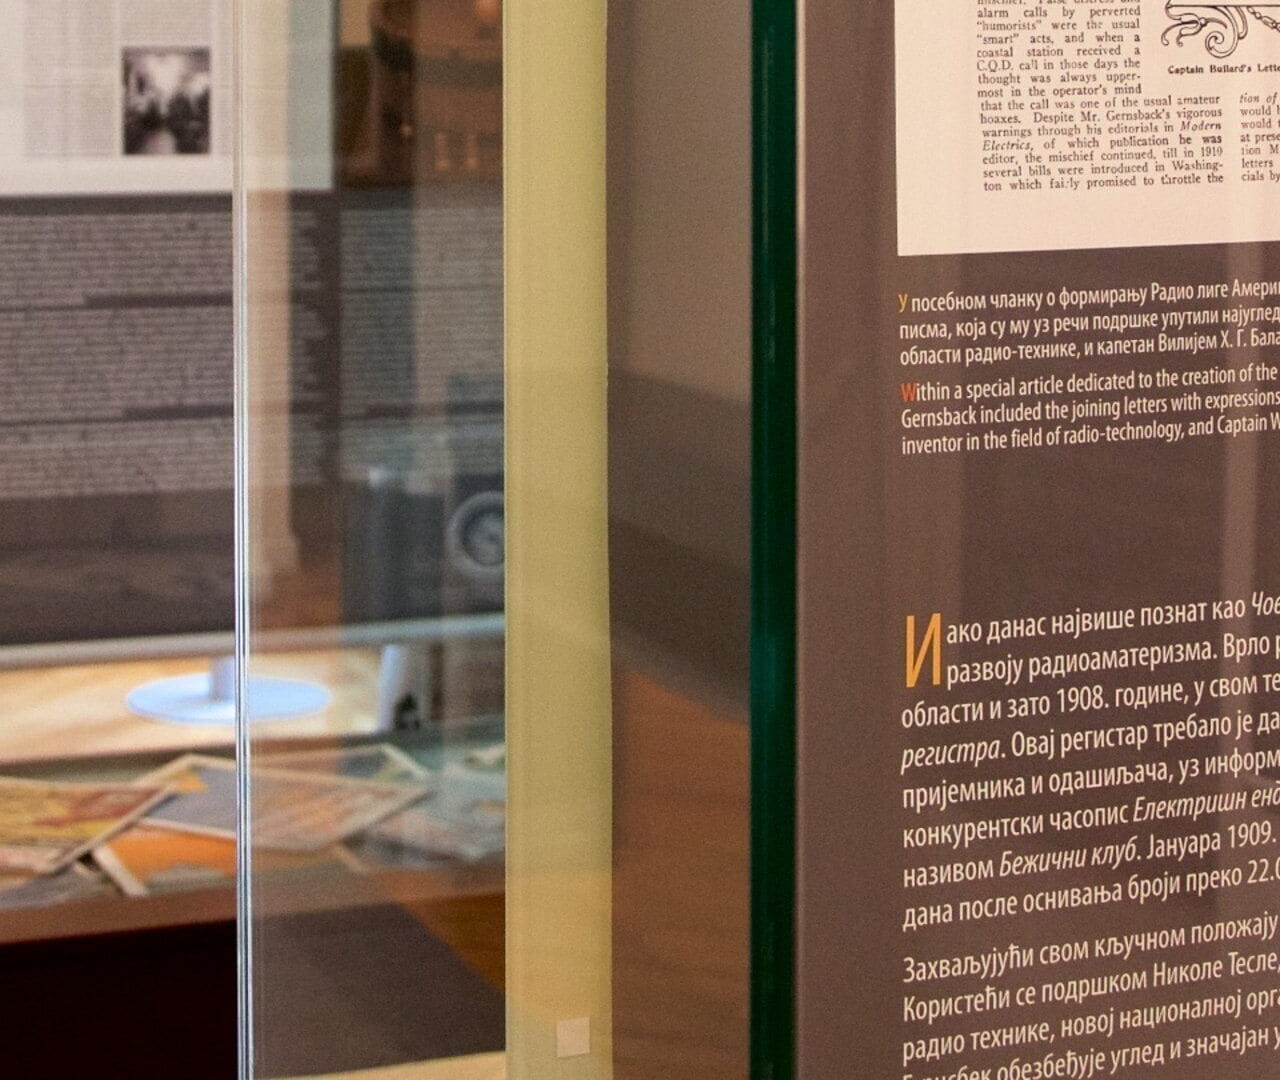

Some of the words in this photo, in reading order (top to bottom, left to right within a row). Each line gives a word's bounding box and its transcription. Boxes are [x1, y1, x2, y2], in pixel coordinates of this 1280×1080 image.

[900, 345, 961, 366] области
[966, 342, 1080, 367] радио-технике,
[1085, 342, 1093, 356] и
[1097, 338, 1154, 355] капетан
[1159, 332, 1217, 355] Вилијем
[1221, 330, 1233, 348] Х.
[1237, 328, 1247, 347] Г.
[902, 436, 963, 455] inventor
[967, 436, 979, 450] in
[984, 430, 1007, 450] the
[1011, 427, 1042, 448] field
[1046, 425, 1061, 446] of
[1064, 419, 1184, 445] radio-technology,
[1188, 416, 1213, 436] and
[1217, 413, 1267, 438] Captain
[987, 617, 1046, 645] данас
[1052, 608, 1135, 640] највише
[1141, 602, 1207, 626] познат
[1213, 598, 1246, 620] као
